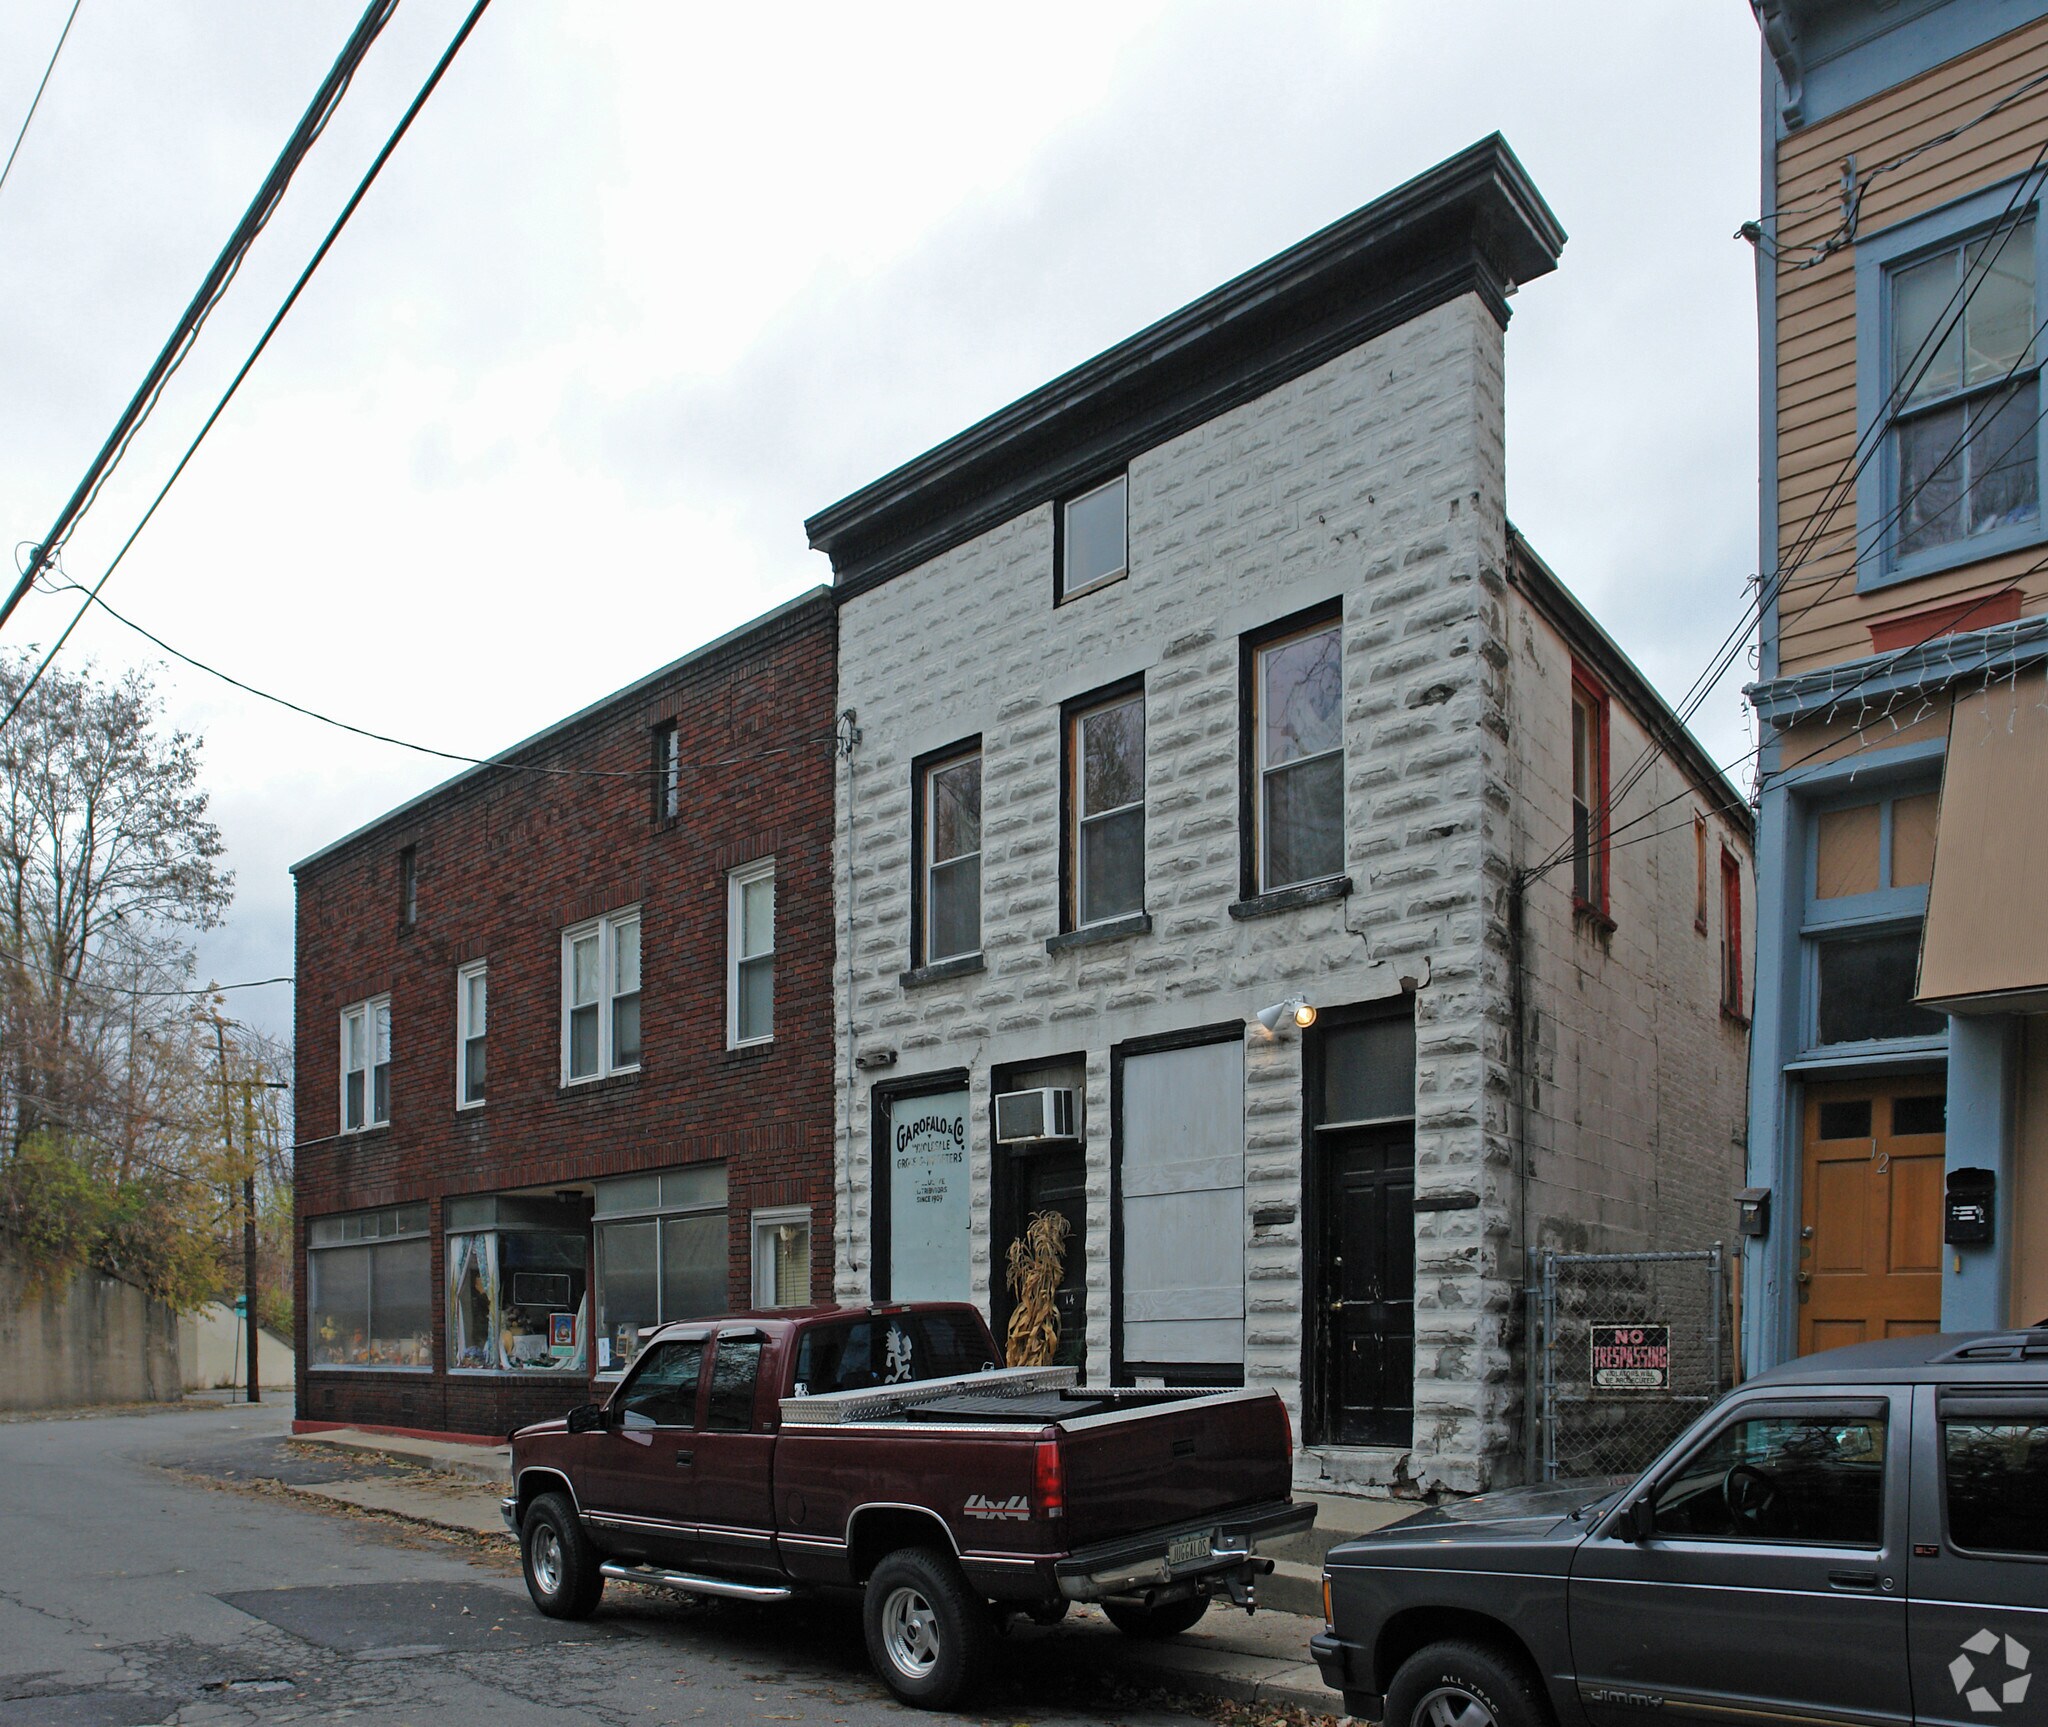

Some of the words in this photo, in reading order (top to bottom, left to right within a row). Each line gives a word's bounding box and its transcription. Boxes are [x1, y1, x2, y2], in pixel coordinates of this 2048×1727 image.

[896, 1115, 947, 1153] GAROFALO
[1871, 1138, 1889, 1174] 12
[916, 1195, 931, 1203] SINCE
[1065, 1294, 1075, 1305] 14
[1614, 1329, 1645, 1345] NO
[1594, 1346, 1667, 1368] TRESPASSING
[963, 1494, 1031, 1521] 4x4
[1172, 1539, 1207, 1563] JUGGALOS
[1441, 1675, 1465, 1686] ALL
[1469, 1682, 1499, 1714] TRAC
